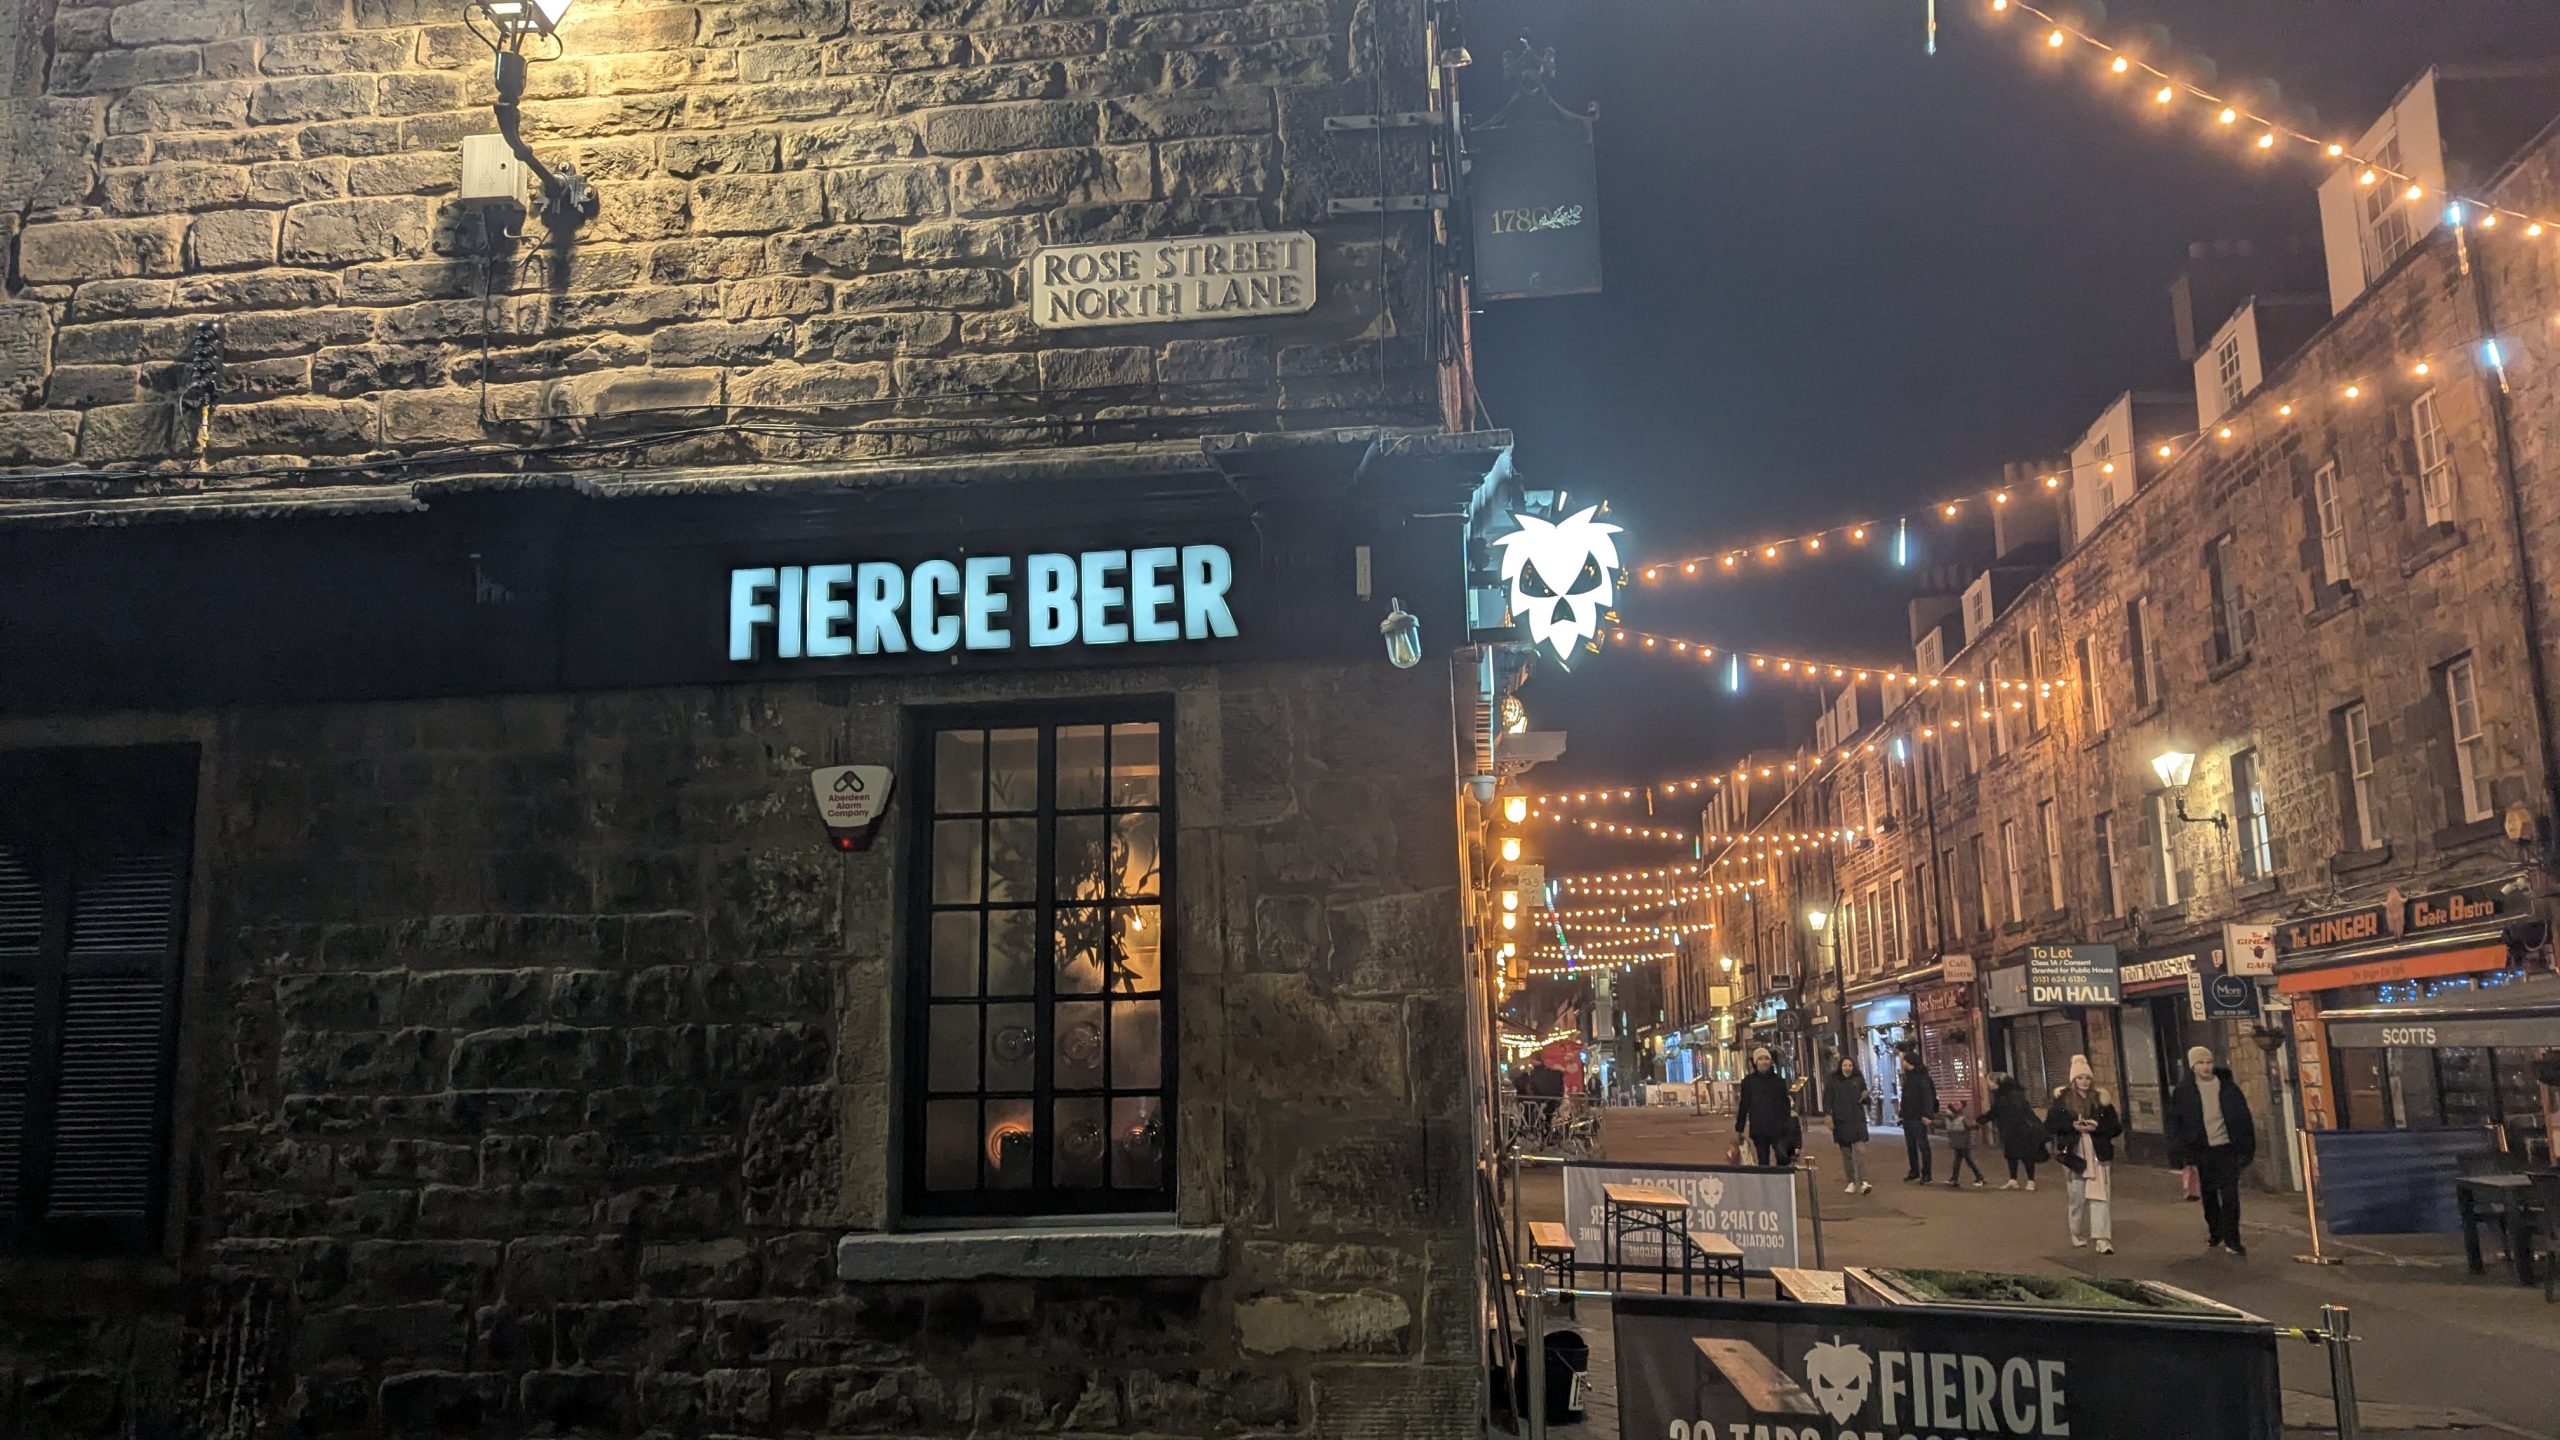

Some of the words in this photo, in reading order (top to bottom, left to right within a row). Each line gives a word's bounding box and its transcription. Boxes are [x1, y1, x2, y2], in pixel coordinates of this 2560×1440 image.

[1043, 250, 1140, 286] ROSE
[1154, 239, 1302, 277] STREET
[1049, 281, 1182, 322] NORTH
[1196, 273, 1298, 312] LANE
[729, 556, 1011, 661] FIERCE
[1028, 544, 1239, 648] BEER
[828, 794, 870, 802] Aberdeen
[836, 802, 862, 810] Alarm
[828, 809, 869, 817] Company
[2030, 946, 2047, 958] To
[2050, 946, 2073, 958] Let
[2190, 974, 2201, 996] LET
[2033, 986, 2063, 1002] DM
[2066, 986, 2116, 1002] HALL
[2193, 1002, 2204, 1018] TO
[2383, 1027, 2437, 1045] SCOTTS
[1878, 1350, 2070, 1436] FIERCE
